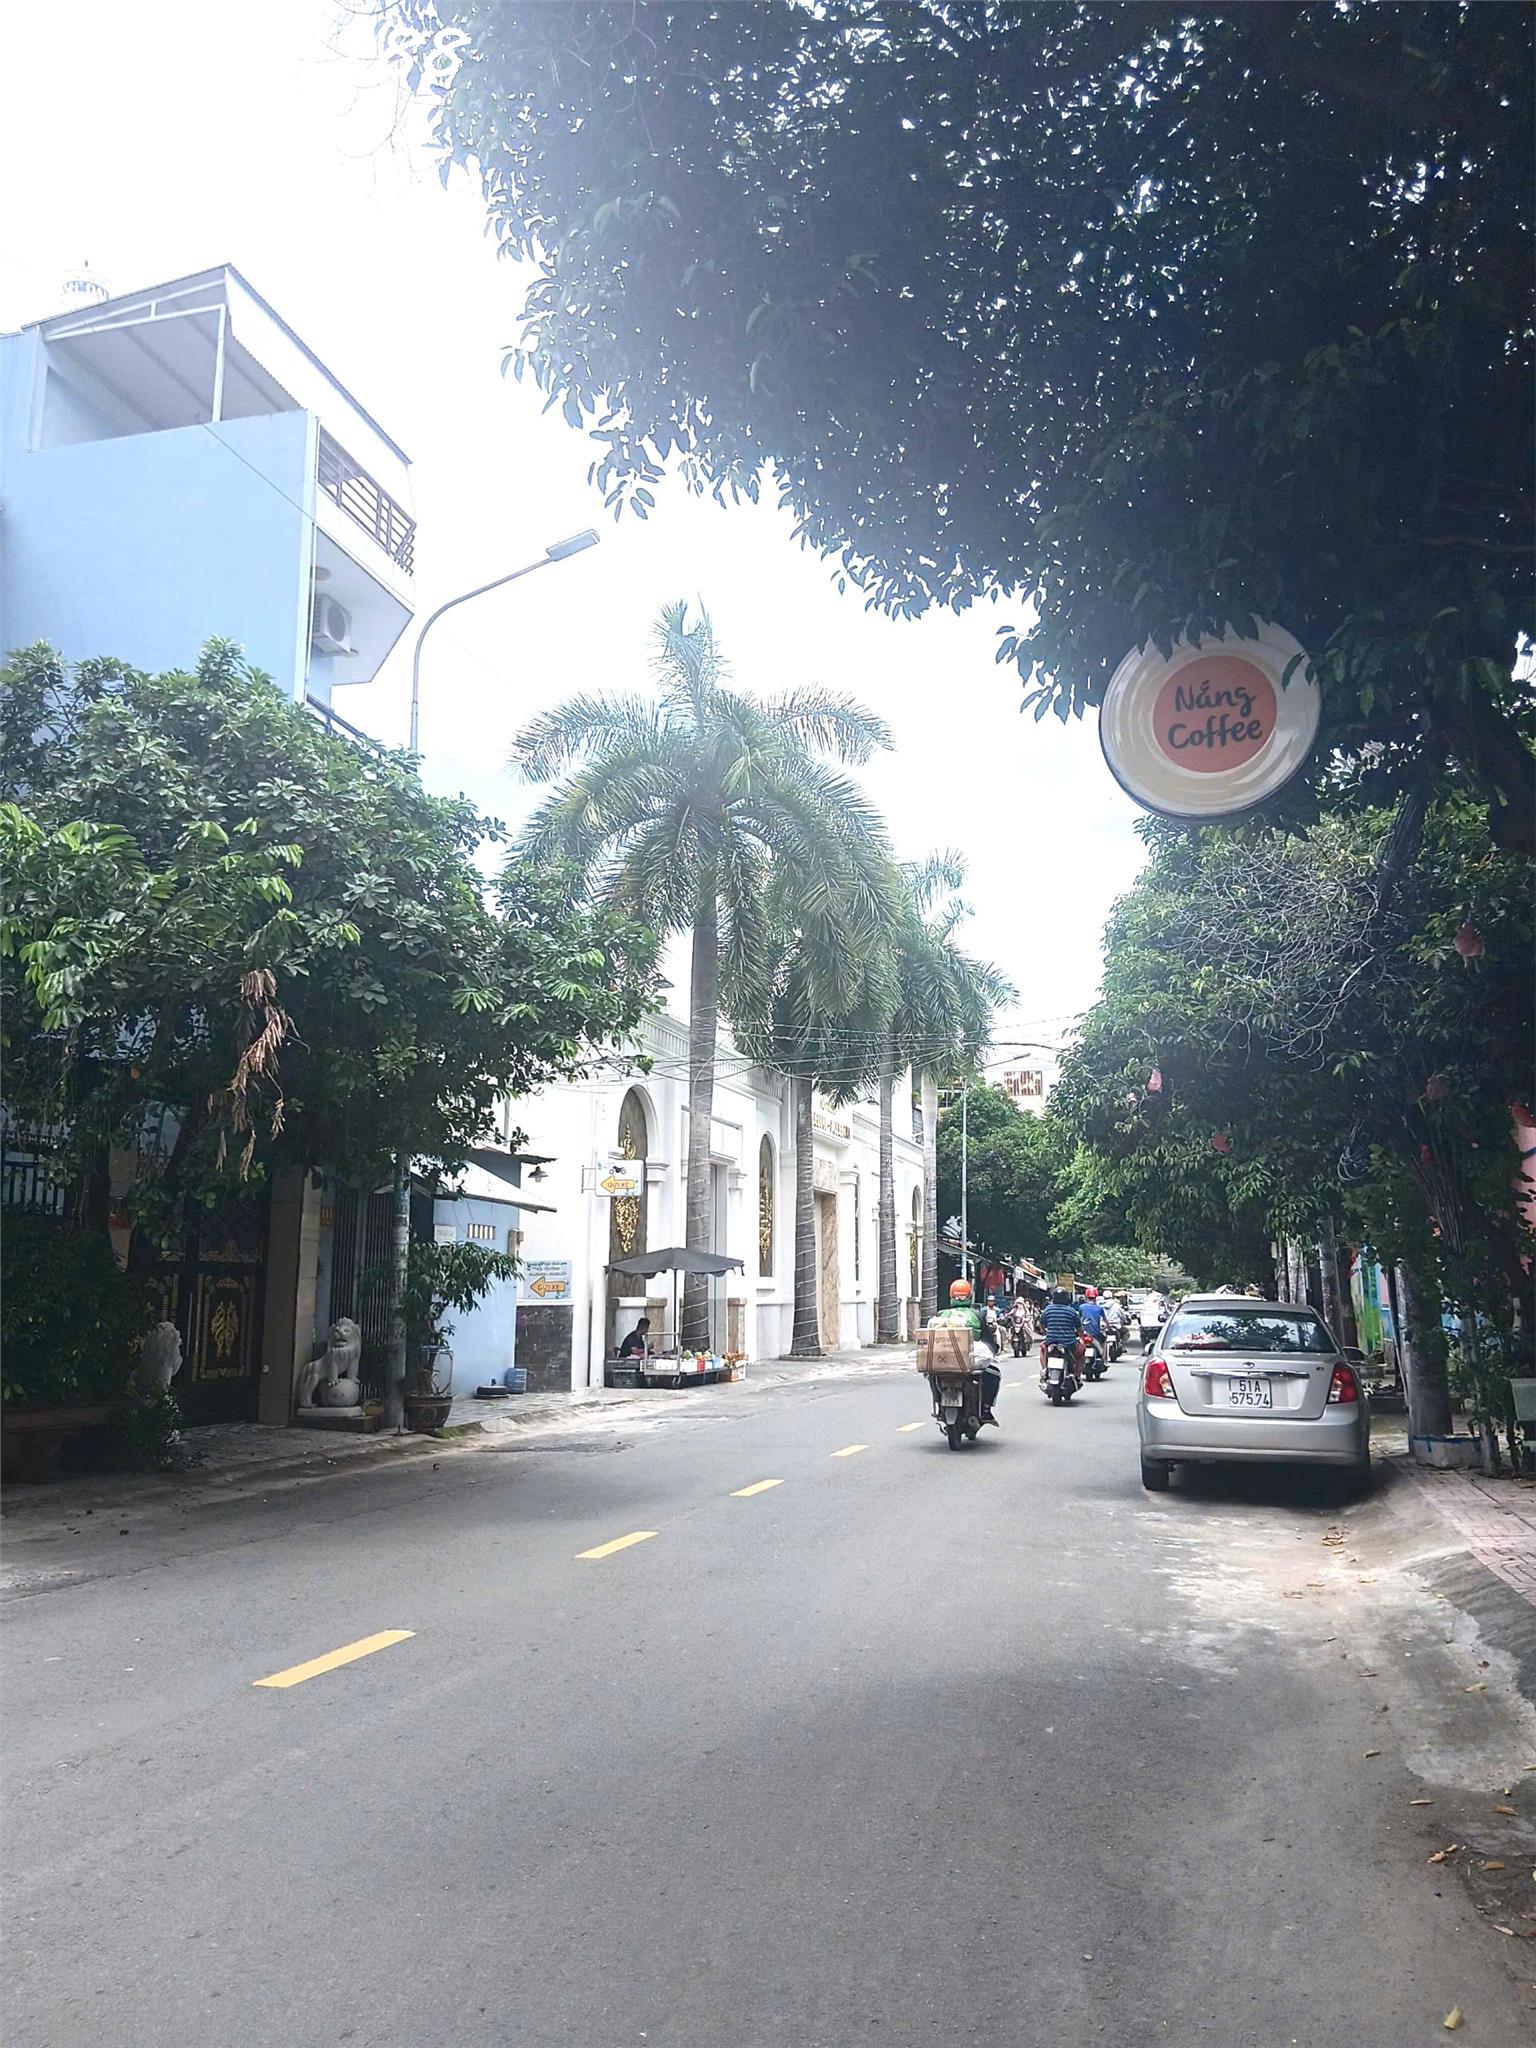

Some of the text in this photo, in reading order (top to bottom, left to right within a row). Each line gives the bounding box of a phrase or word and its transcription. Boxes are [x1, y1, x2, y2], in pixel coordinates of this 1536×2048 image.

[1175, 680, 1257, 718] Nắng
[1168, 713, 1262, 748] Coffee
[1239, 1380, 1261, 1393] 51A
